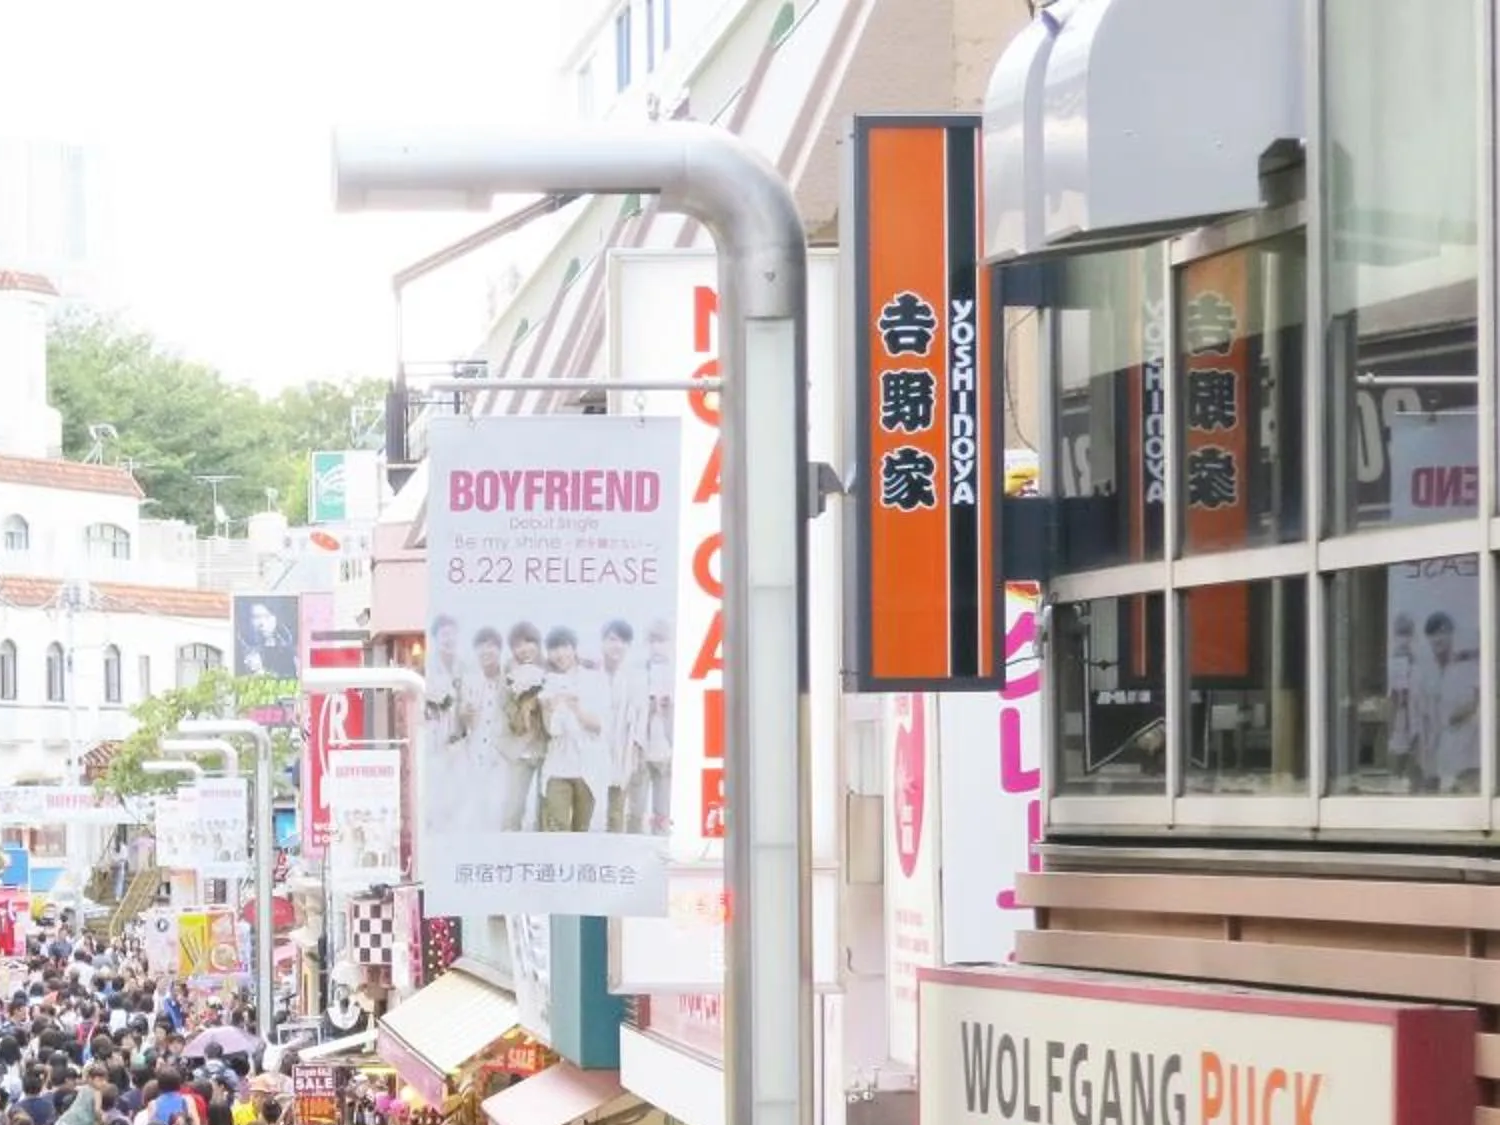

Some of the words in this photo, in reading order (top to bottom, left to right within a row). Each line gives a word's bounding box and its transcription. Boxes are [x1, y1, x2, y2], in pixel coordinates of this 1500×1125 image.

[877, 290, 938, 512] 吉野家
[950, 299, 975, 505] YOSHINOYA
[450, 469, 661, 513] BOYFRIEND
[447, 557, 514, 585] 8.22
[524, 557, 659, 585] RELEASE
[454, 862, 639, 886] 原宿竹下通り商店会
[295, 1077, 334, 1090] SALE
